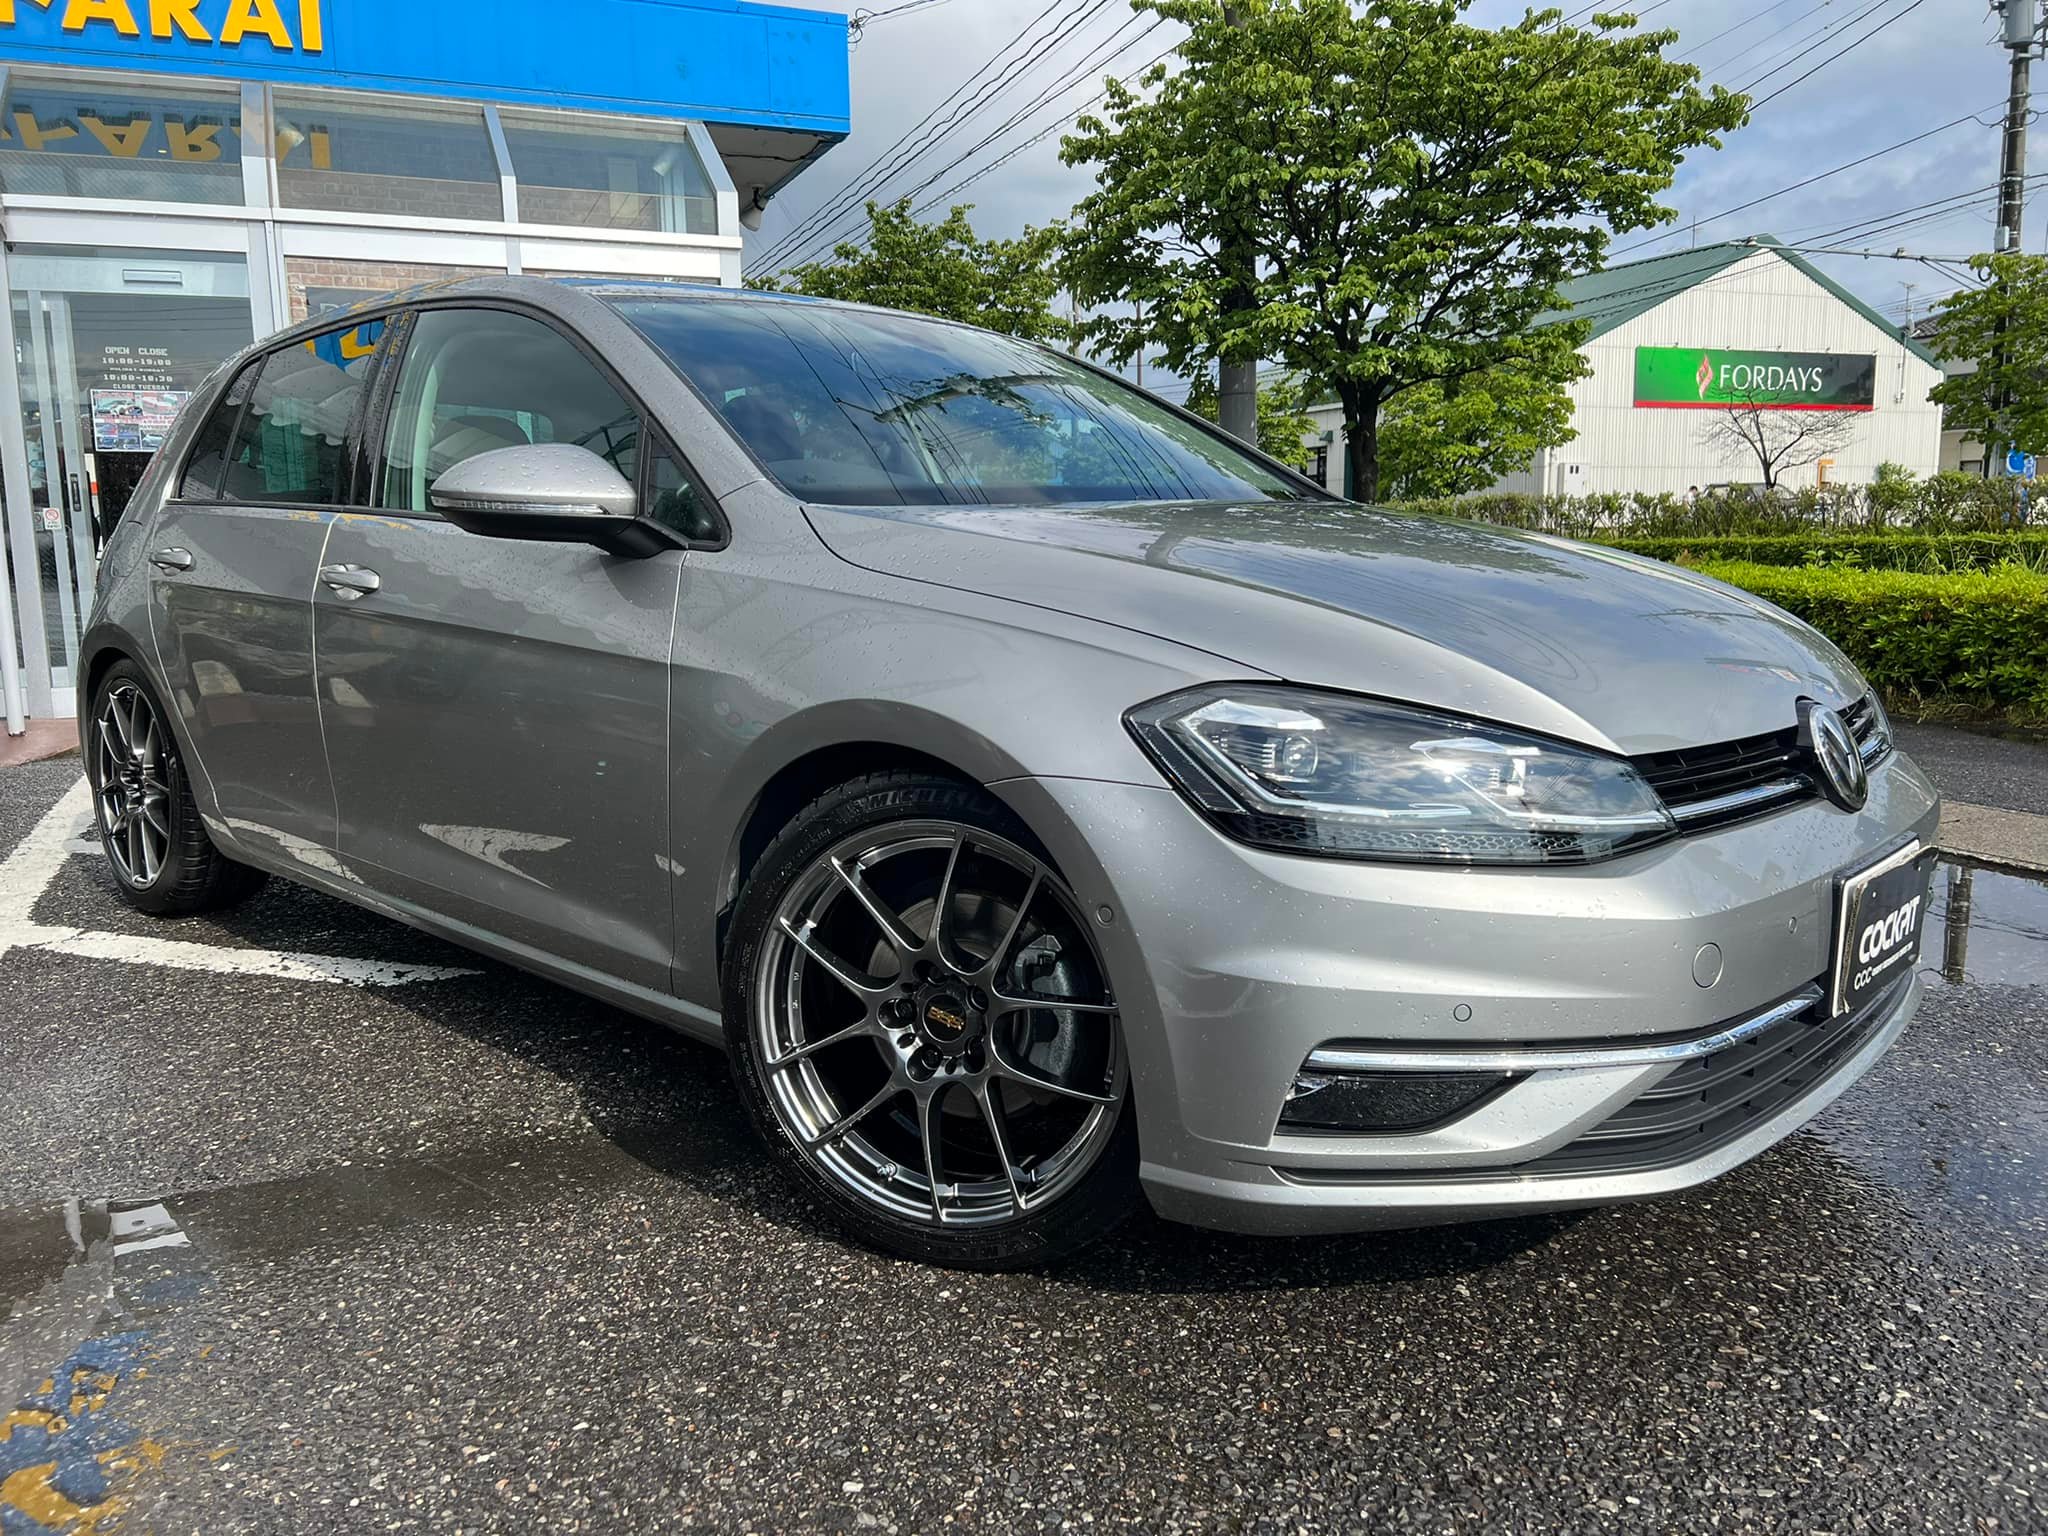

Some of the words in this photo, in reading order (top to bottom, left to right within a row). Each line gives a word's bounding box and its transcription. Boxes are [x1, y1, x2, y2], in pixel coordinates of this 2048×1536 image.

[104, 345, 130, 355] OPEN
[138, 347, 168, 356] CLOSE
[1719, 364, 1823, 392] FORDAYS
[1858, 895, 1921, 964] COCKPIT
